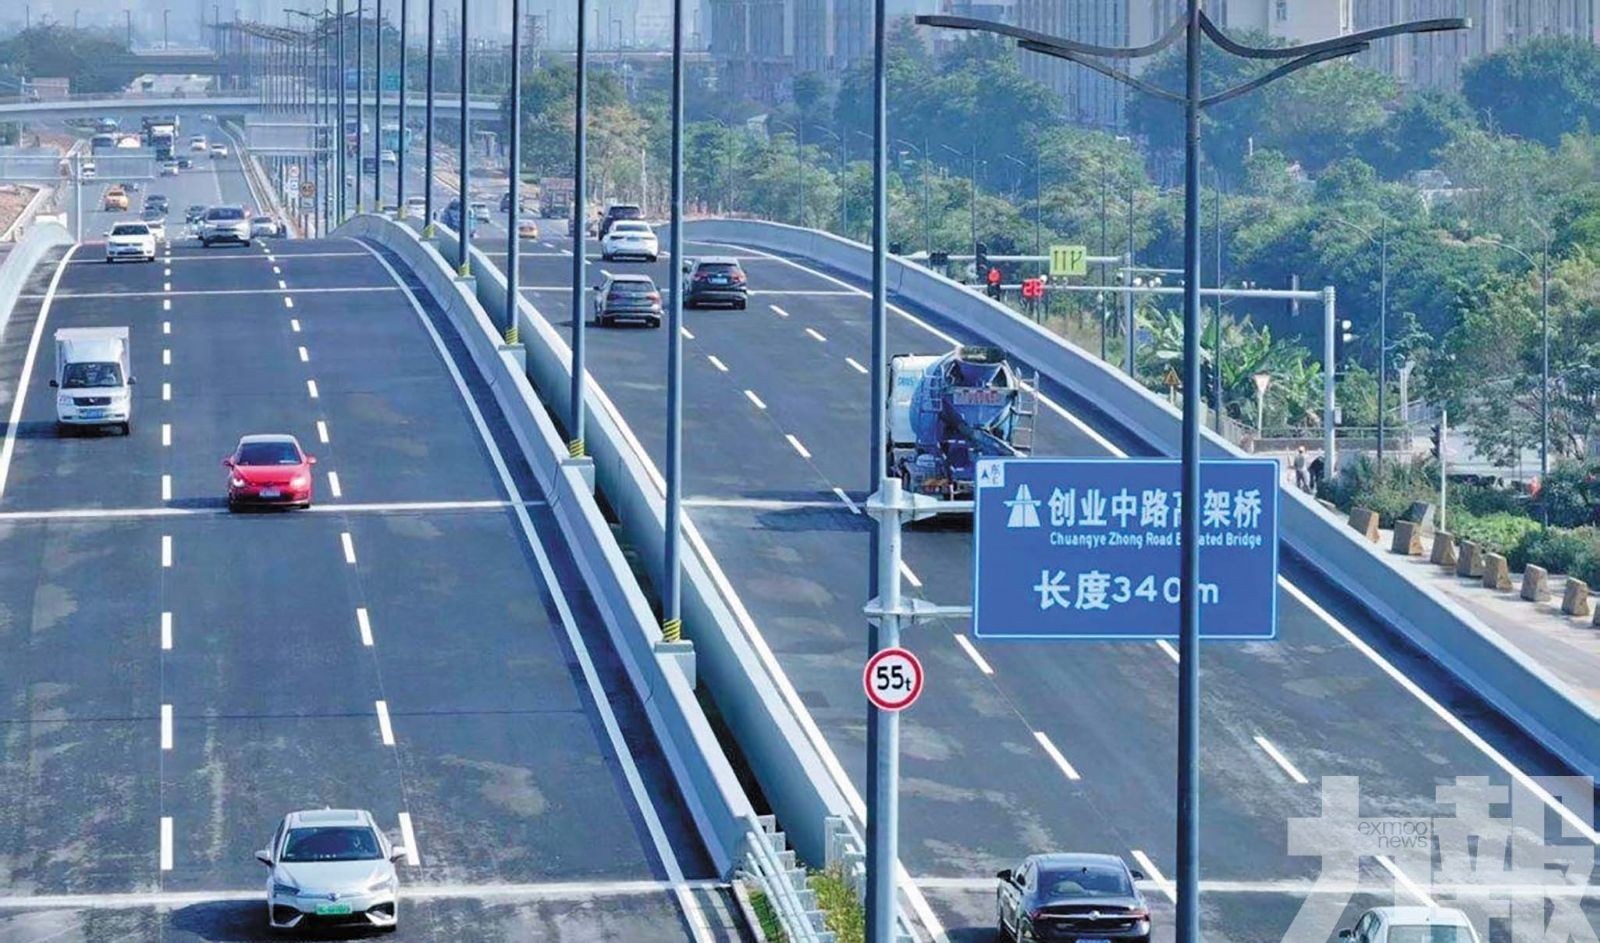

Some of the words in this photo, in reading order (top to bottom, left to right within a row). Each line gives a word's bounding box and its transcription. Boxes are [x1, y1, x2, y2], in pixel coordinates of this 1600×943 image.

[1050, 532, 1107, 549] Chuangye
[1109, 531, 1143, 549] Zhong
[1146, 531, 1173, 546] Road
[1176, 531, 1223, 546] Eated
[1226, 531, 1262, 549] Bridge
[877, 665, 911, 691] 55t
